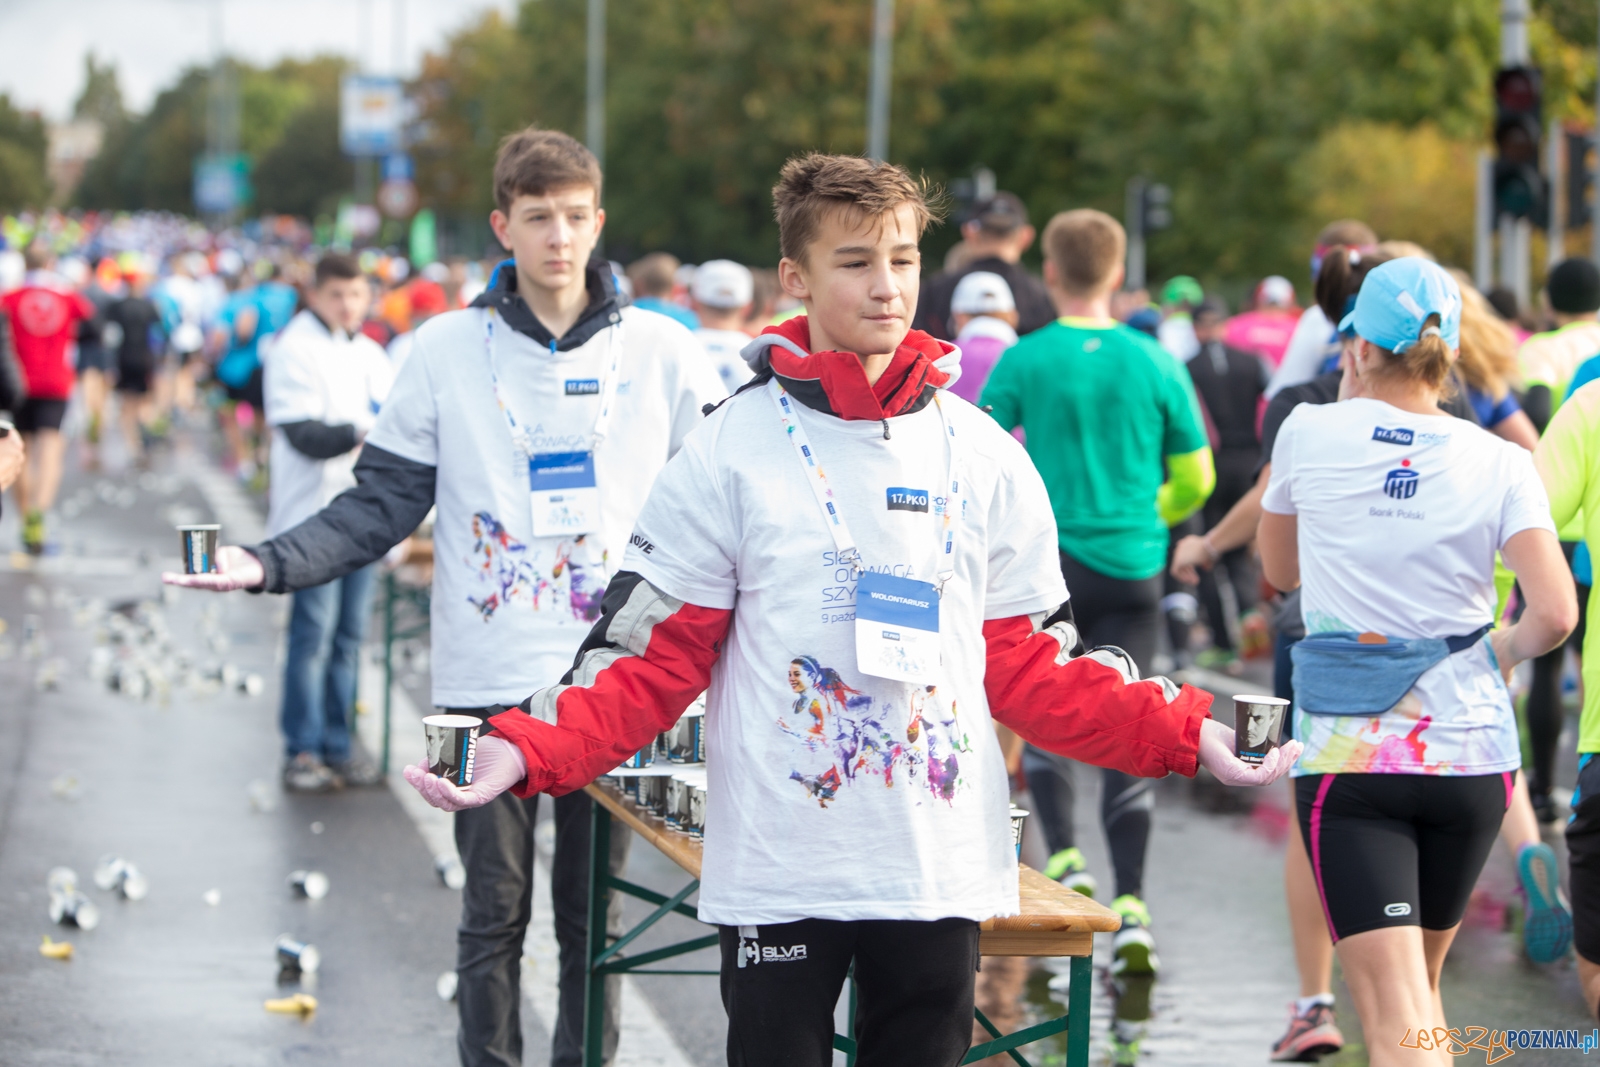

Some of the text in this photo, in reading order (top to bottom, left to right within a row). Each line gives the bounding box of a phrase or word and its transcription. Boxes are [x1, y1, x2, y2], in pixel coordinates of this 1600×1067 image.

[1377, 430, 1411, 443] 17.PKO
[891, 493, 927, 506] 17.PKO
[1369, 506, 1426, 520] Bank Polski
[822, 585, 858, 602] SZY
[870, 591, 930, 609] WOLONTARIUSZ
[821, 611, 857, 624] 9 paźd
[762, 944, 807, 958] SLVR
